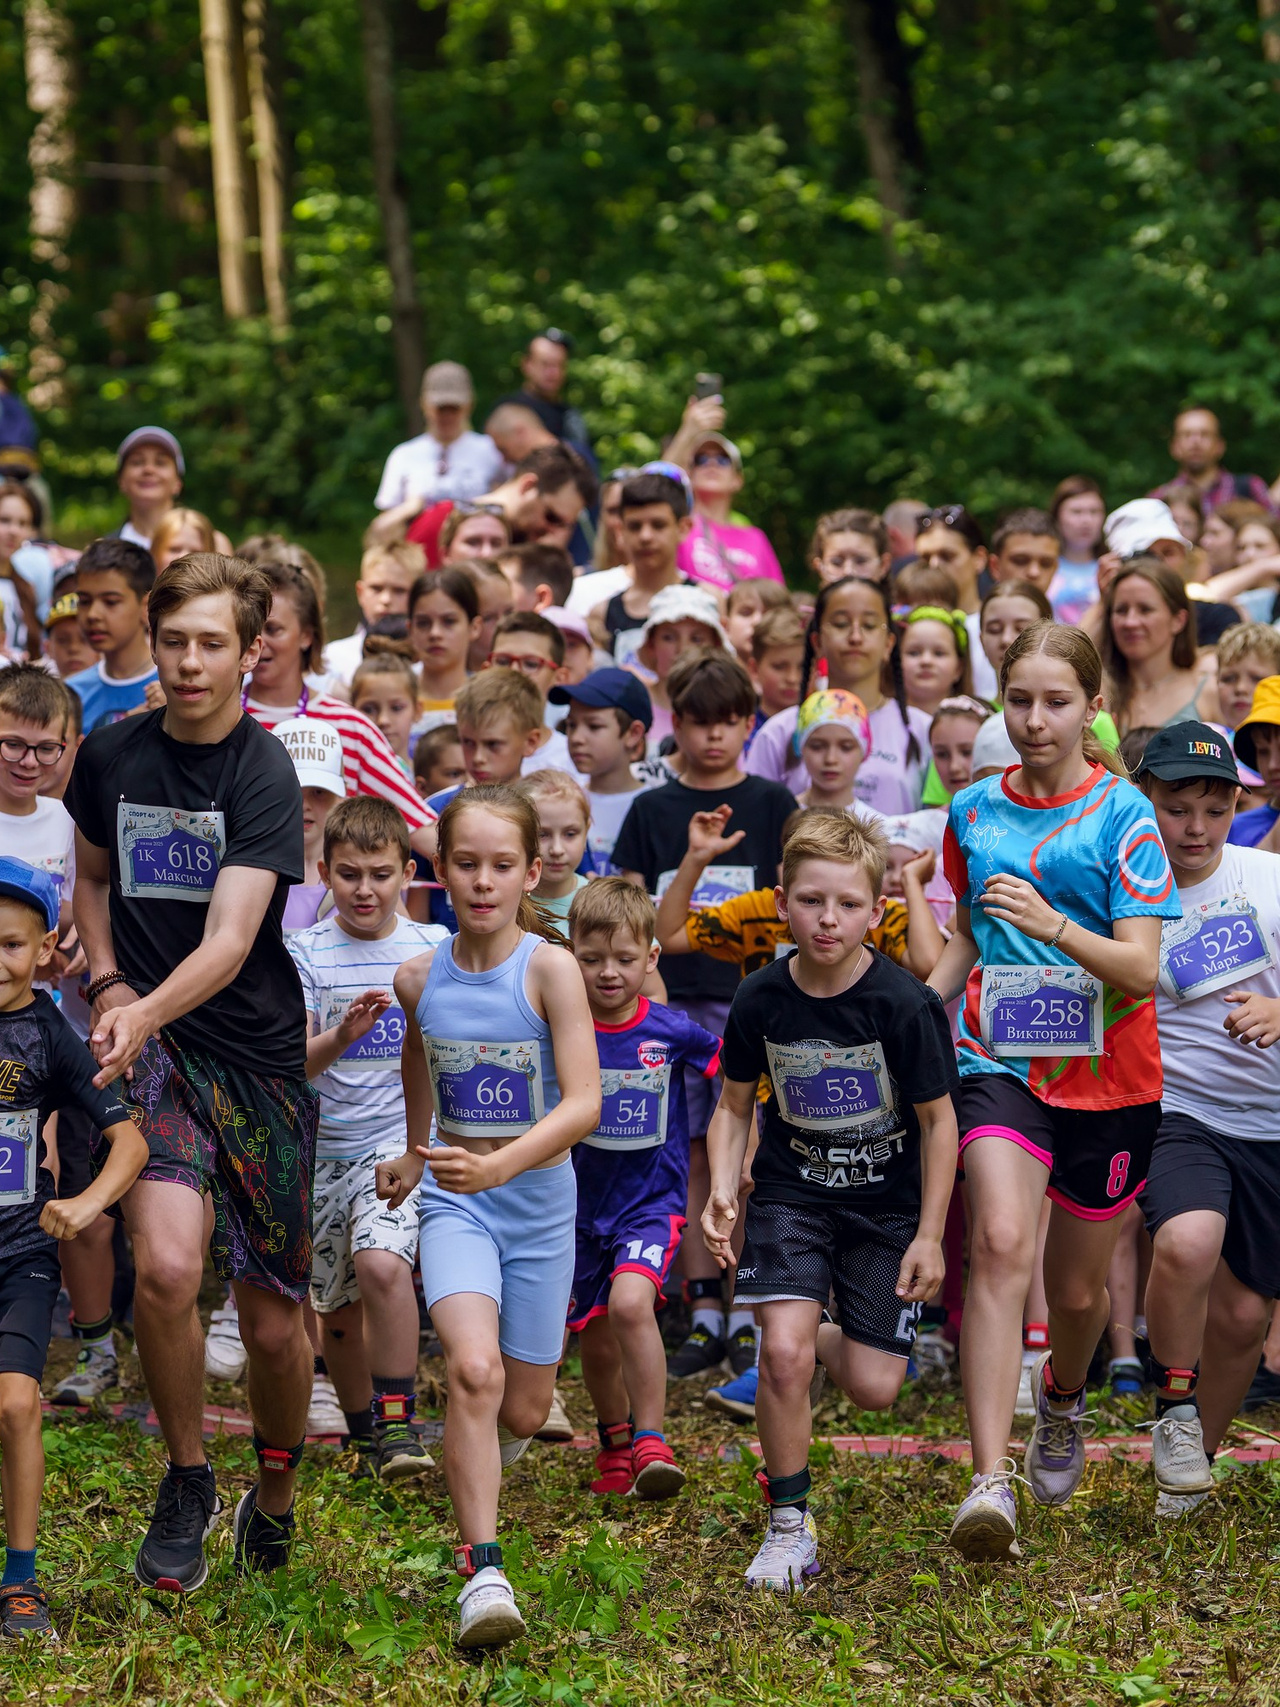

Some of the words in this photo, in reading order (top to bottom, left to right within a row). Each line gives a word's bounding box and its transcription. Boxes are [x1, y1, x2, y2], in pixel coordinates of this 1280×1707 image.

[277, 731, 316, 745] TATE
[322, 733, 337, 748] OF
[288, 747, 325, 761] MIND
[168, 841, 212, 872] 618
[153, 868, 203, 885] Максим
[1200, 920, 1253, 960] 523
[1201, 954, 1241, 976] Марк
[1029, 998, 1084, 1026] 258
[371, 1017, 407, 1044] 33
[1007, 1026, 1077, 1043] Виктория
[476, 1077, 513, 1106] 66
[825, 1076, 863, 1103] 53
[448, 1103, 520, 1119] Анастасия
[616, 1098, 648, 1123] 54
[799, 1098, 868, 1118] Григорий
[1106, 1150, 1131, 1198] 8
[626, 1239, 665, 1269] 14
